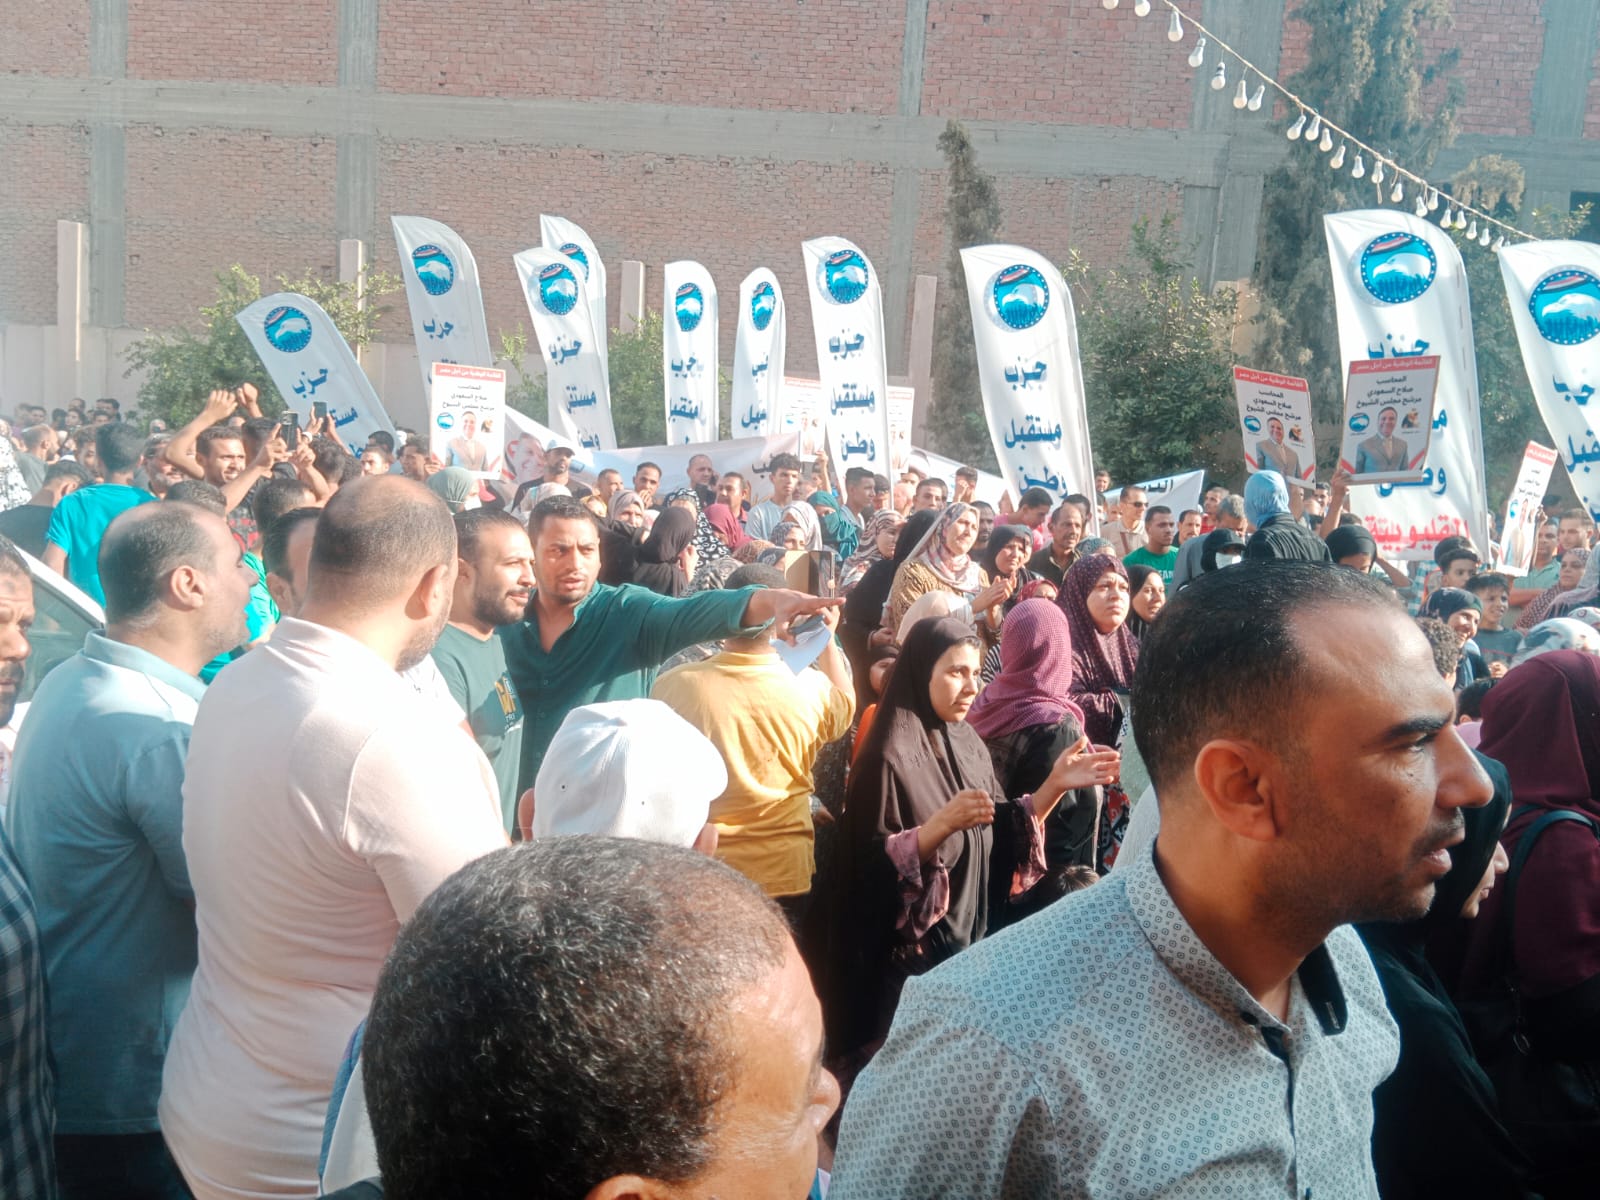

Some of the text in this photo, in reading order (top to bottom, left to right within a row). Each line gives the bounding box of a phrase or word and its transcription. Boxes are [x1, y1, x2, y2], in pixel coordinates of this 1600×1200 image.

[828, 328, 865, 360] حزب
[292, 368, 329, 399] حزب
[1004, 355, 1048, 391] حزب
[830, 383, 875, 416] مستقبل
[841, 431, 876, 461] وطن
[1004, 414, 1063, 450] مستقبل
[1018, 465, 1069, 499] وطن
[1364, 514, 1470, 552] القليوبية
